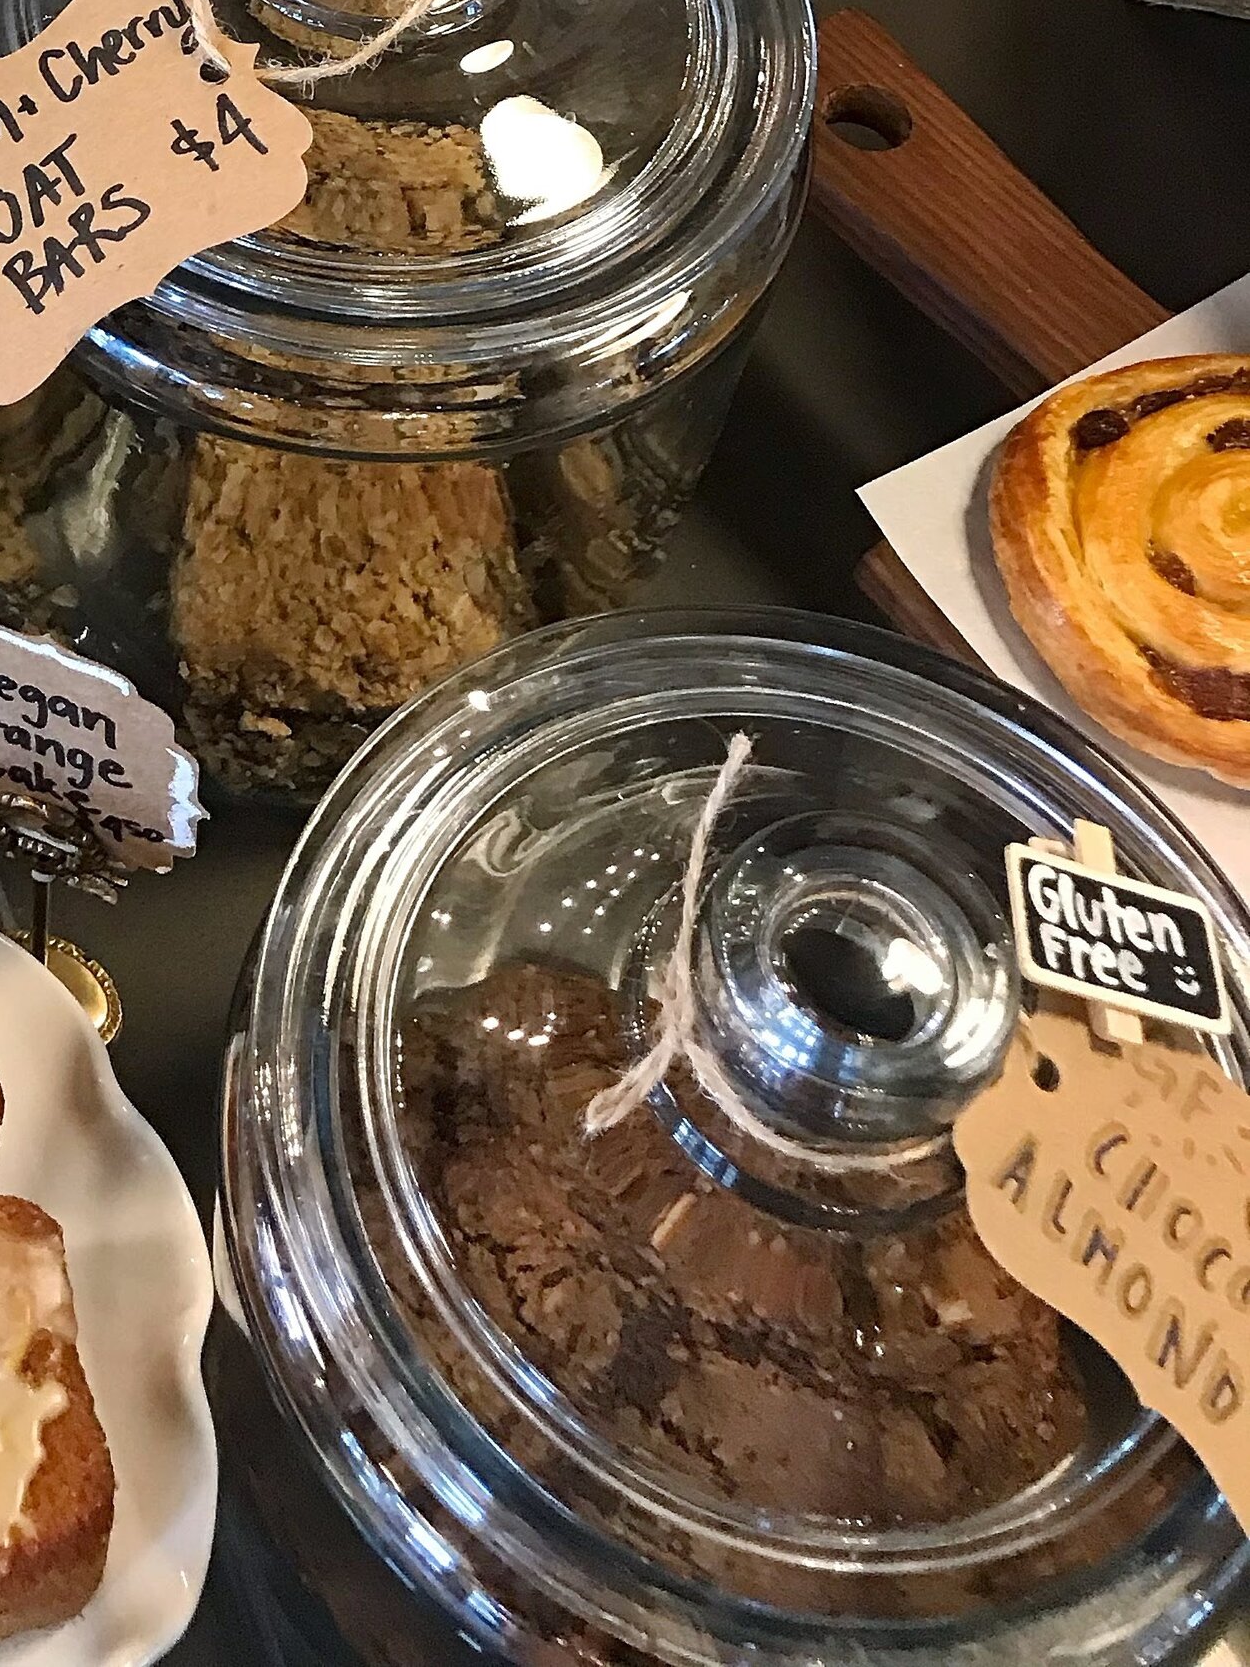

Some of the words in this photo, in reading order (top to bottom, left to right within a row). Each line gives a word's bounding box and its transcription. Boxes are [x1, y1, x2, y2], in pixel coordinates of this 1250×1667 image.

[170, 92, 270, 172] $4
[1, 182, 152, 316] BARS
[1027, 863, 1187, 958] Gluten
[1038, 922, 1151, 993] Free
[989, 1130, 1247, 1427] ALMOND
